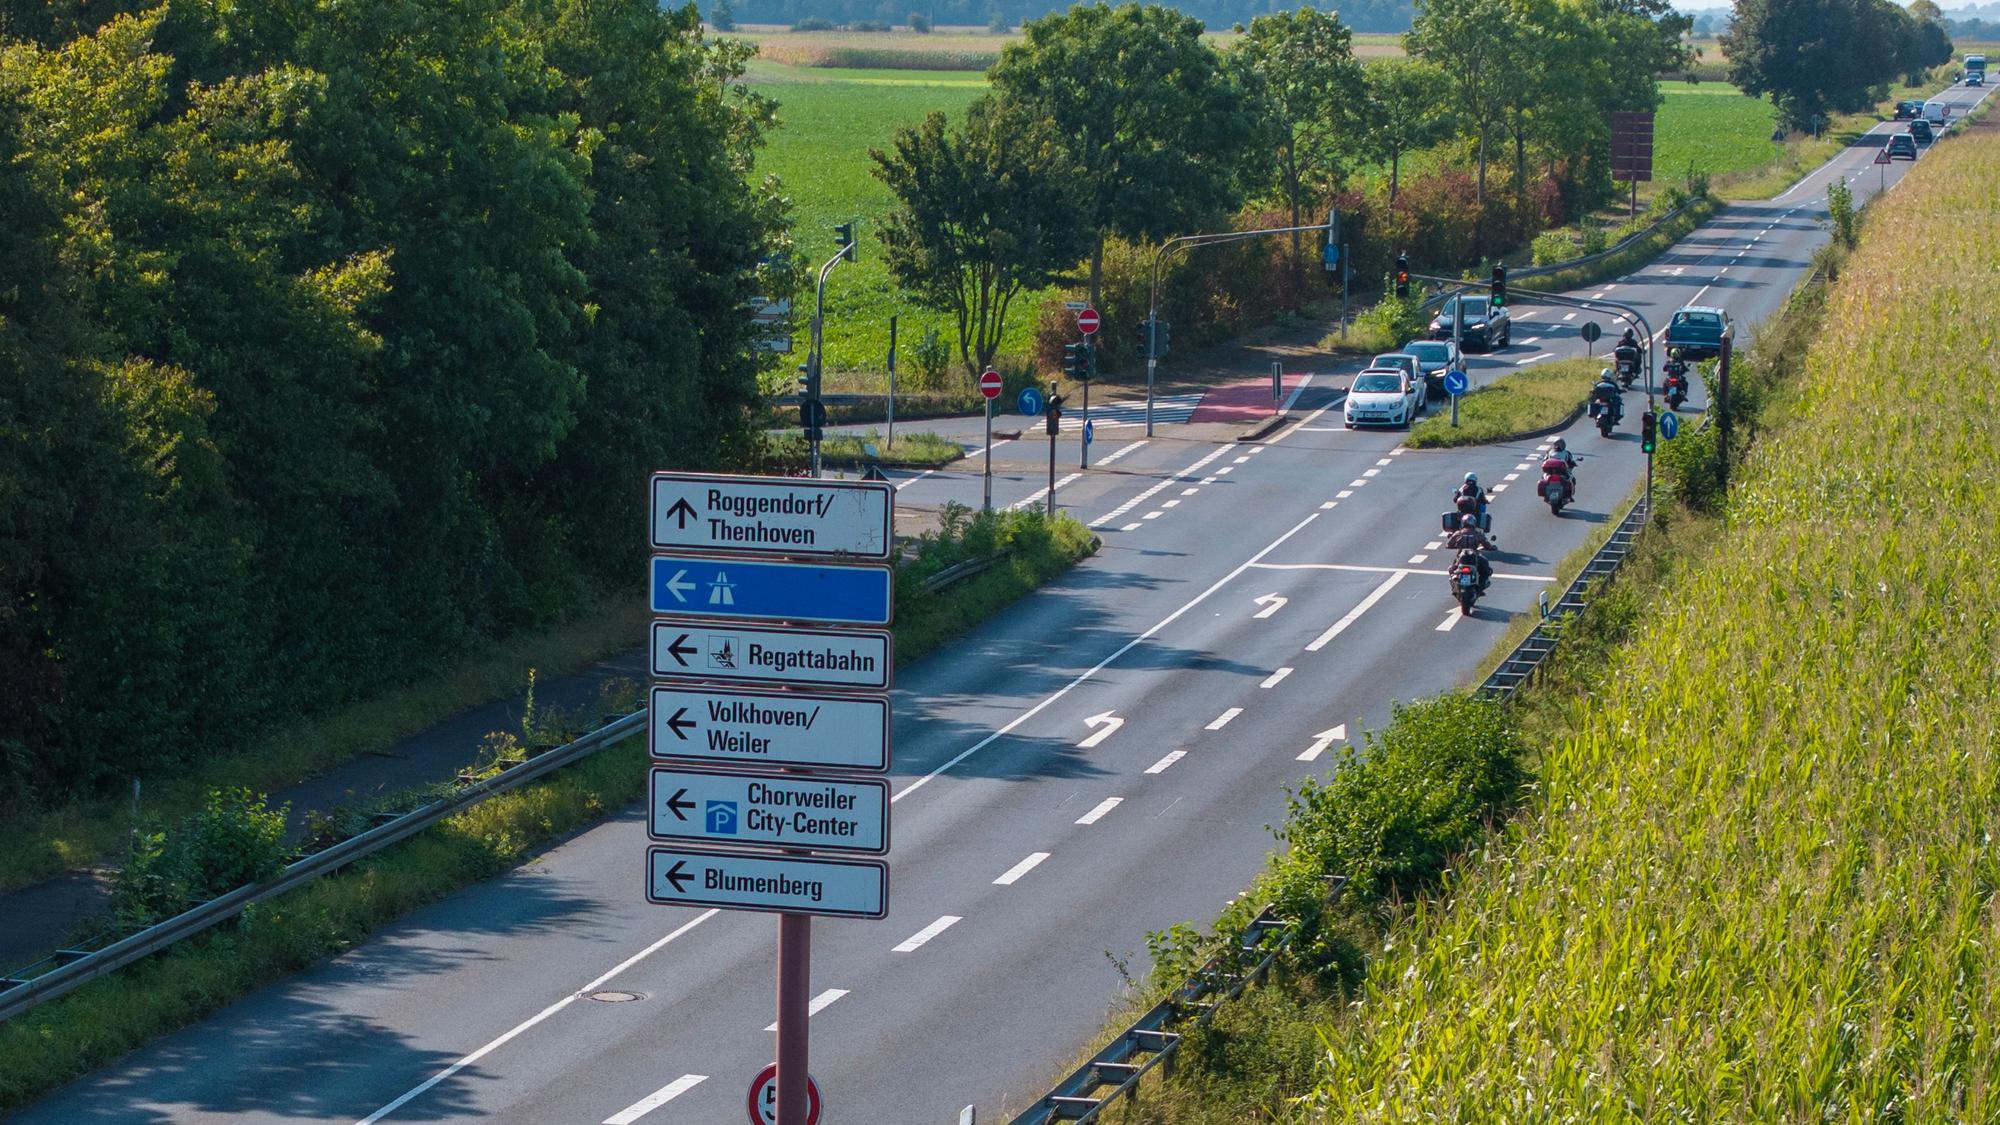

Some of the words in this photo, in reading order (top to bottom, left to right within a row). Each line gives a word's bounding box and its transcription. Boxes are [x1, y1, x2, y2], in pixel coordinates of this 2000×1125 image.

[708, 489, 835, 519] Roggendorf/
[708, 518, 815, 545] Thenhoven
[749, 643, 875, 672] Regattabahn
[707, 700, 821, 730] Volkhoven/
[707, 729, 771, 754] Weiler
[748, 782, 857, 810] Chorweiler
[715, 811, 730, 832] P
[747, 809, 858, 837] City-Center
[705, 868, 823, 902] Blumenberg
